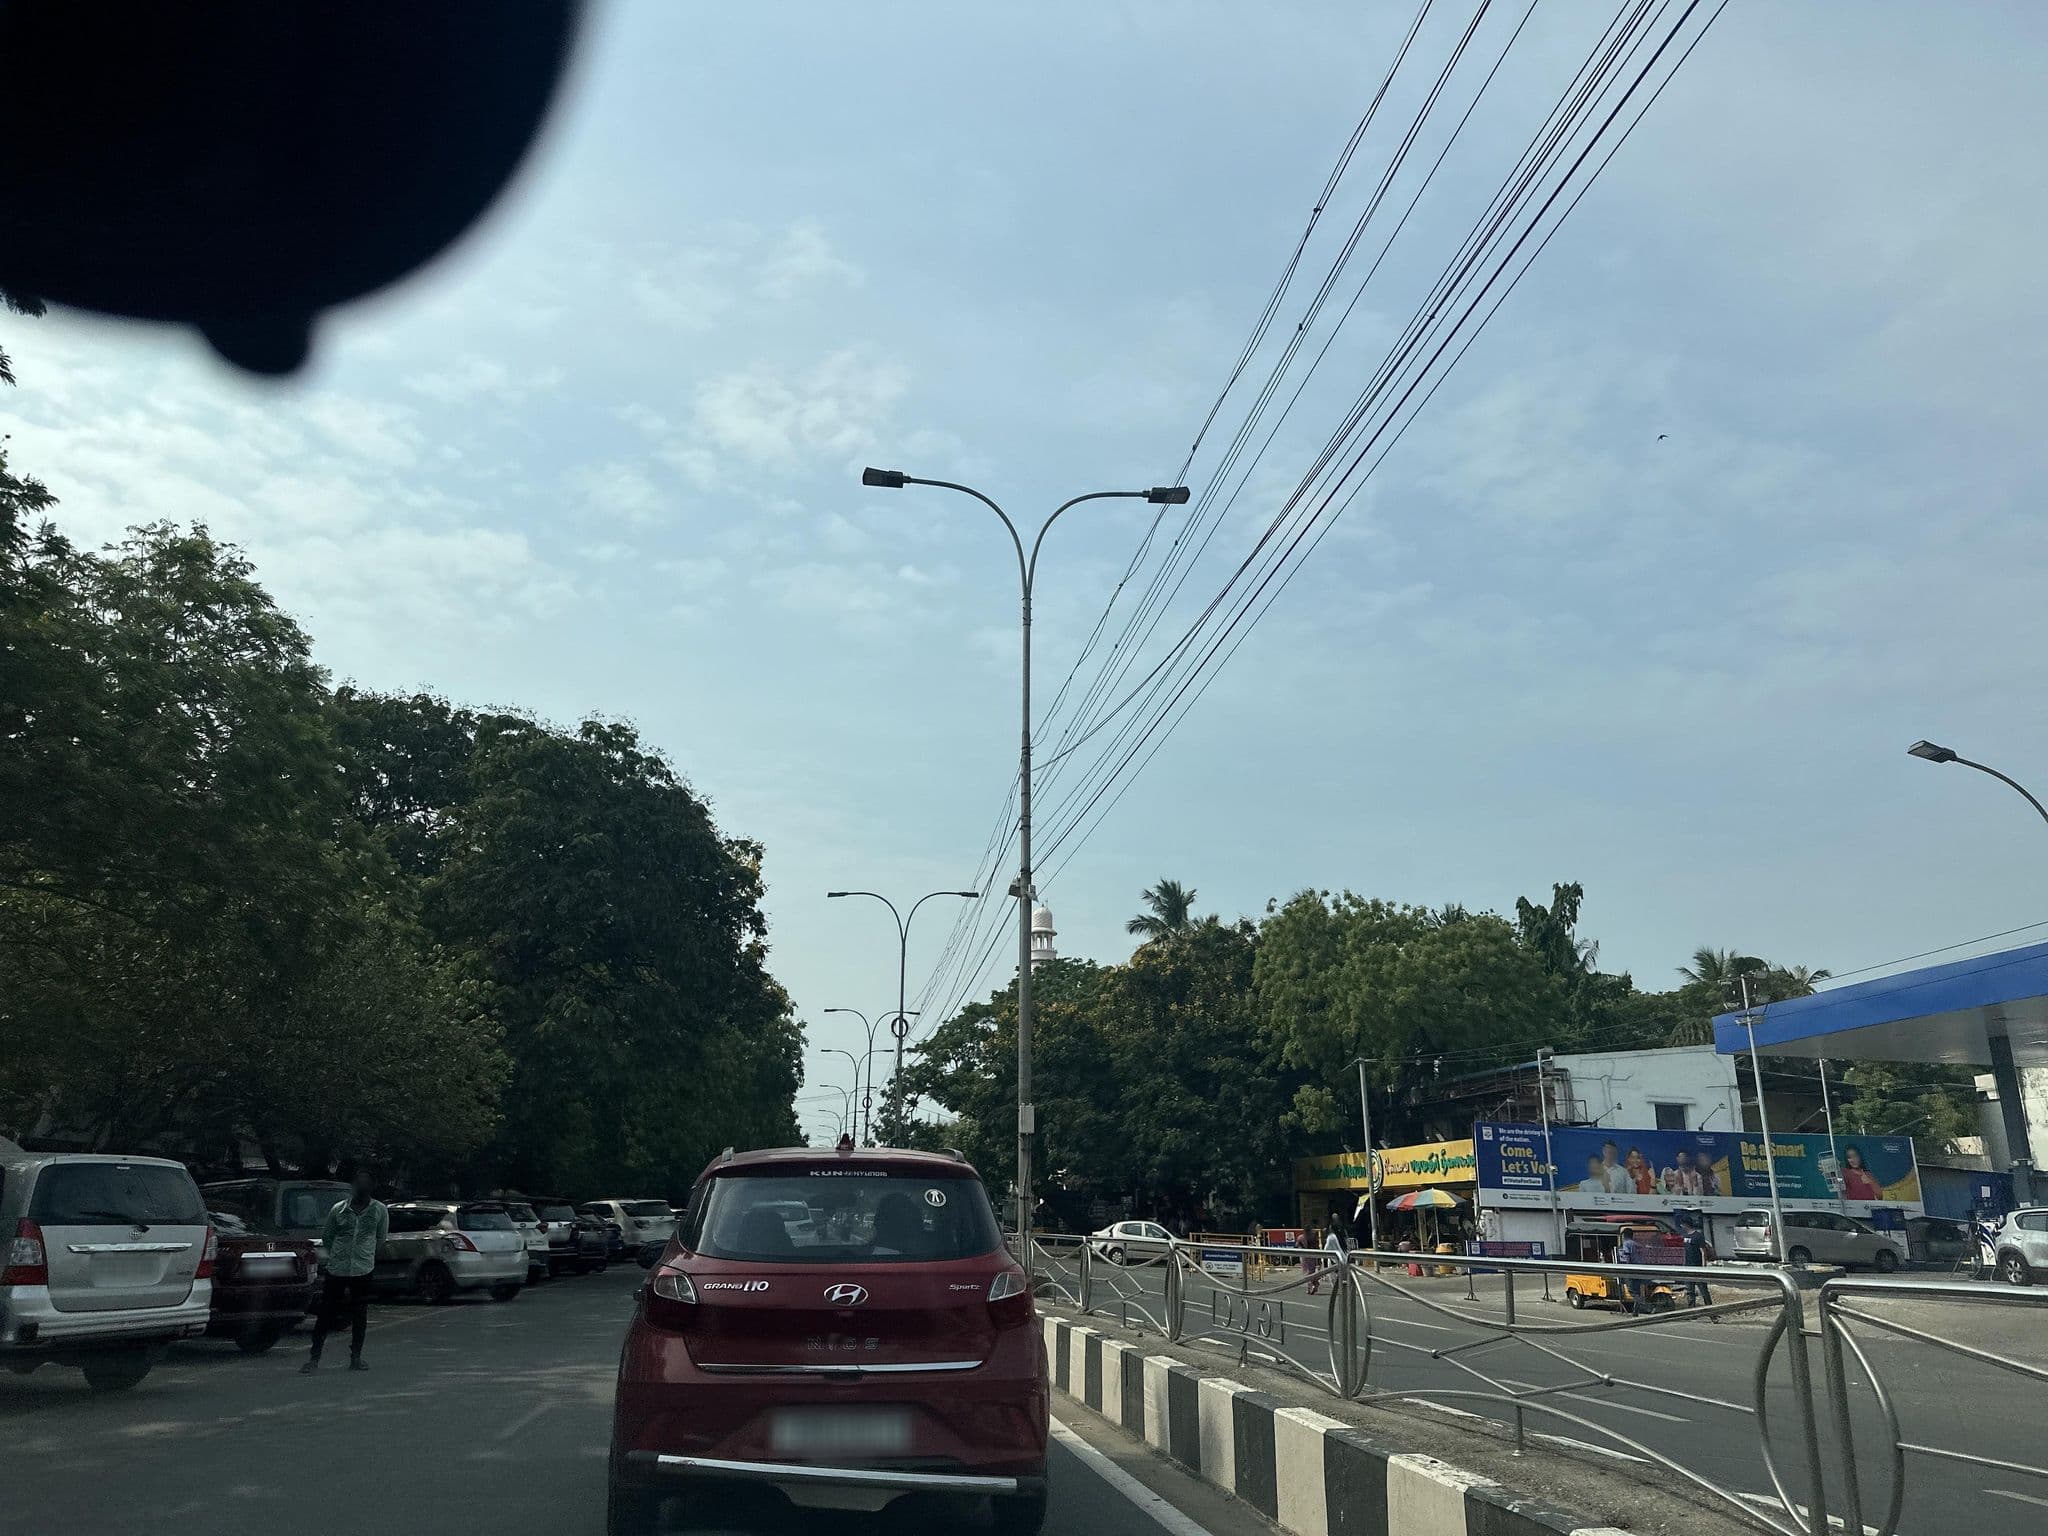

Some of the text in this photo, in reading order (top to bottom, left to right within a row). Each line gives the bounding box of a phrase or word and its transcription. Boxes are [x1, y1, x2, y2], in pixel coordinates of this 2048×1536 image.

[1500, 1143, 1537, 1160] Come,
[1740, 1141, 1757, 1155] Be
[1769, 1142, 1806, 1157] Smart
[1502, 1160, 1529, 1174] Let's
[1742, 1157, 1770, 1171] Vote
